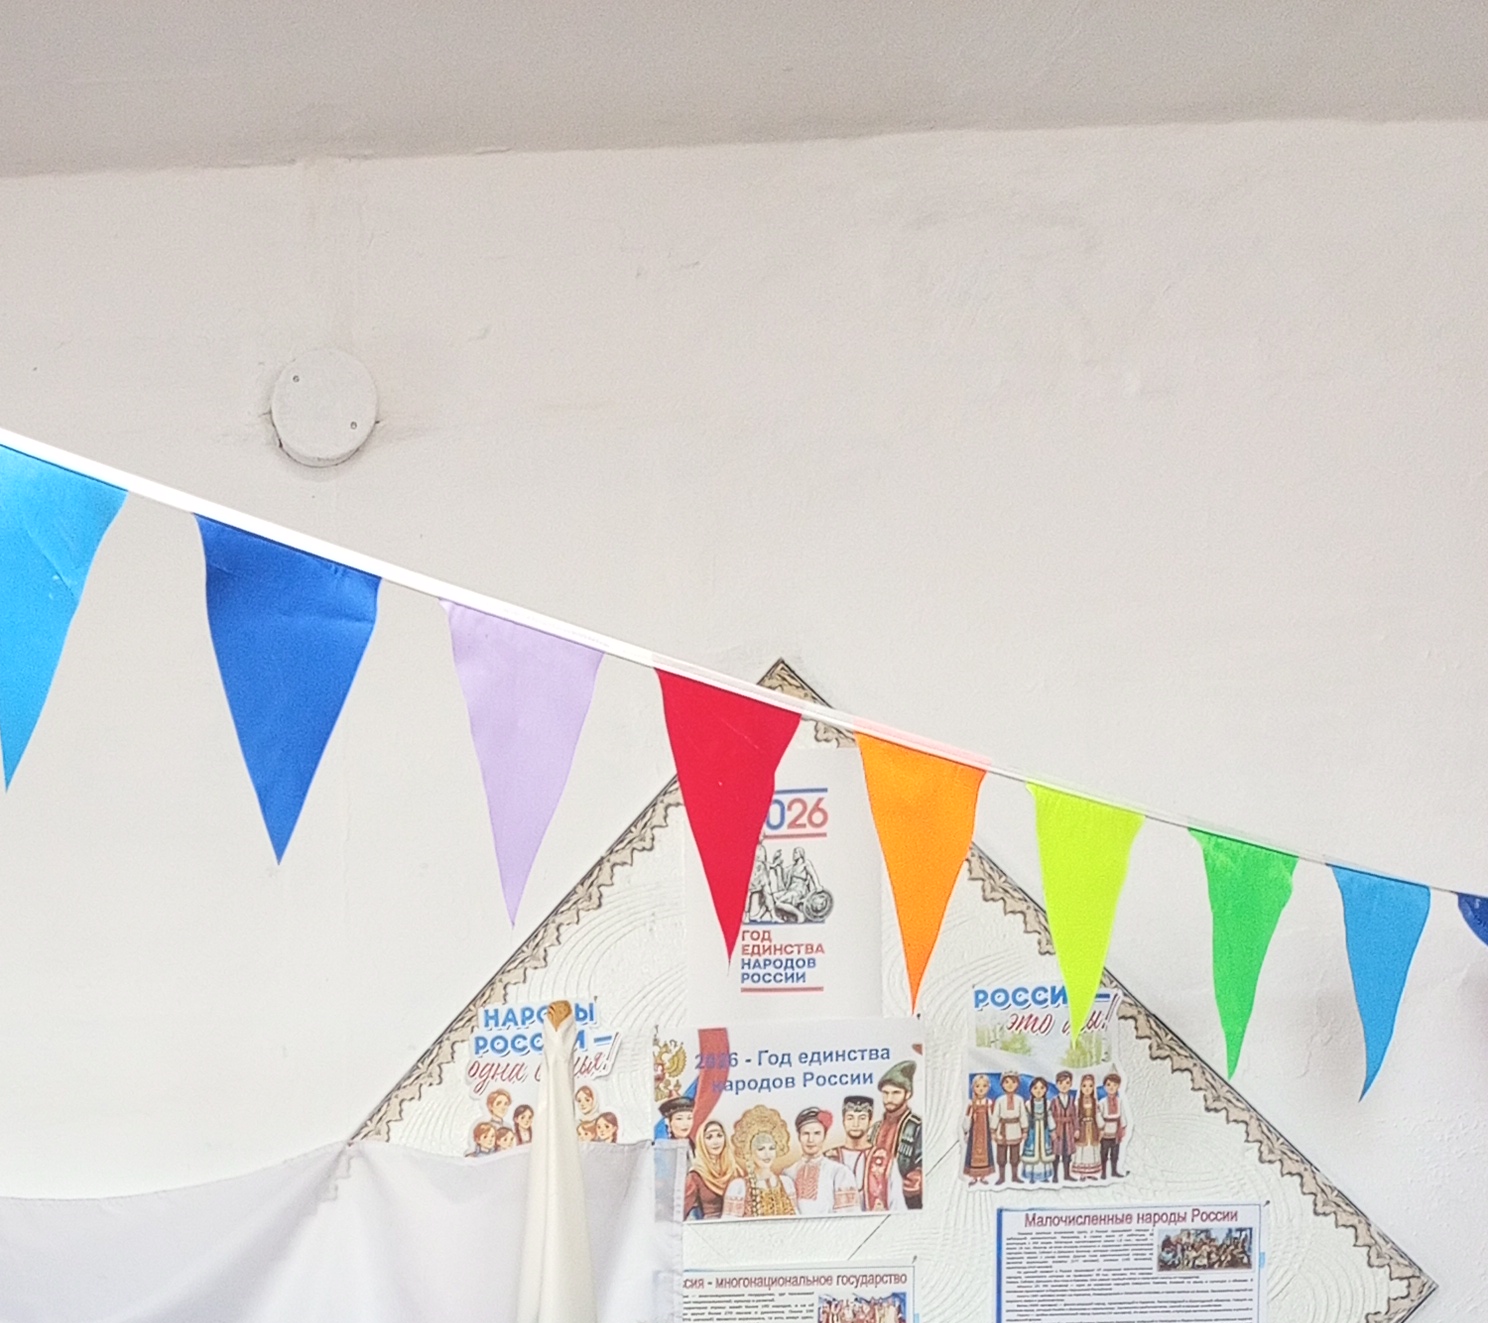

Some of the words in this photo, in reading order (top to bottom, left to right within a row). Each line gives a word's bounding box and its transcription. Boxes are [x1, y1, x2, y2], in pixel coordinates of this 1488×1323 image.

[766, 797, 829, 831] 026
[741, 929, 773, 944] ГОД
[741, 943, 826, 957] ЕДИНСТВА
[741, 957, 817, 971] НАРОДОВ
[741, 971, 806, 985] РОССИИ
[484, 1002, 594, 1028] НАРОЫ
[1007, 1013, 1054, 1033] это
[695, 1052, 739, 1069] 2026
[757, 1050, 792, 1068] Год
[798, 1047, 891, 1066] единства
[713, 1073, 796, 1095] народов
[802, 1071, 874, 1088] России
[1024, 1210, 1133, 1228] Малочисленные
[1136, 1209, 1188, 1228] народы
[1191, 1208, 1239, 1224] России
[715, 1273, 834, 1291] многонациональное
[836, 1271, 908, 1289] государство
